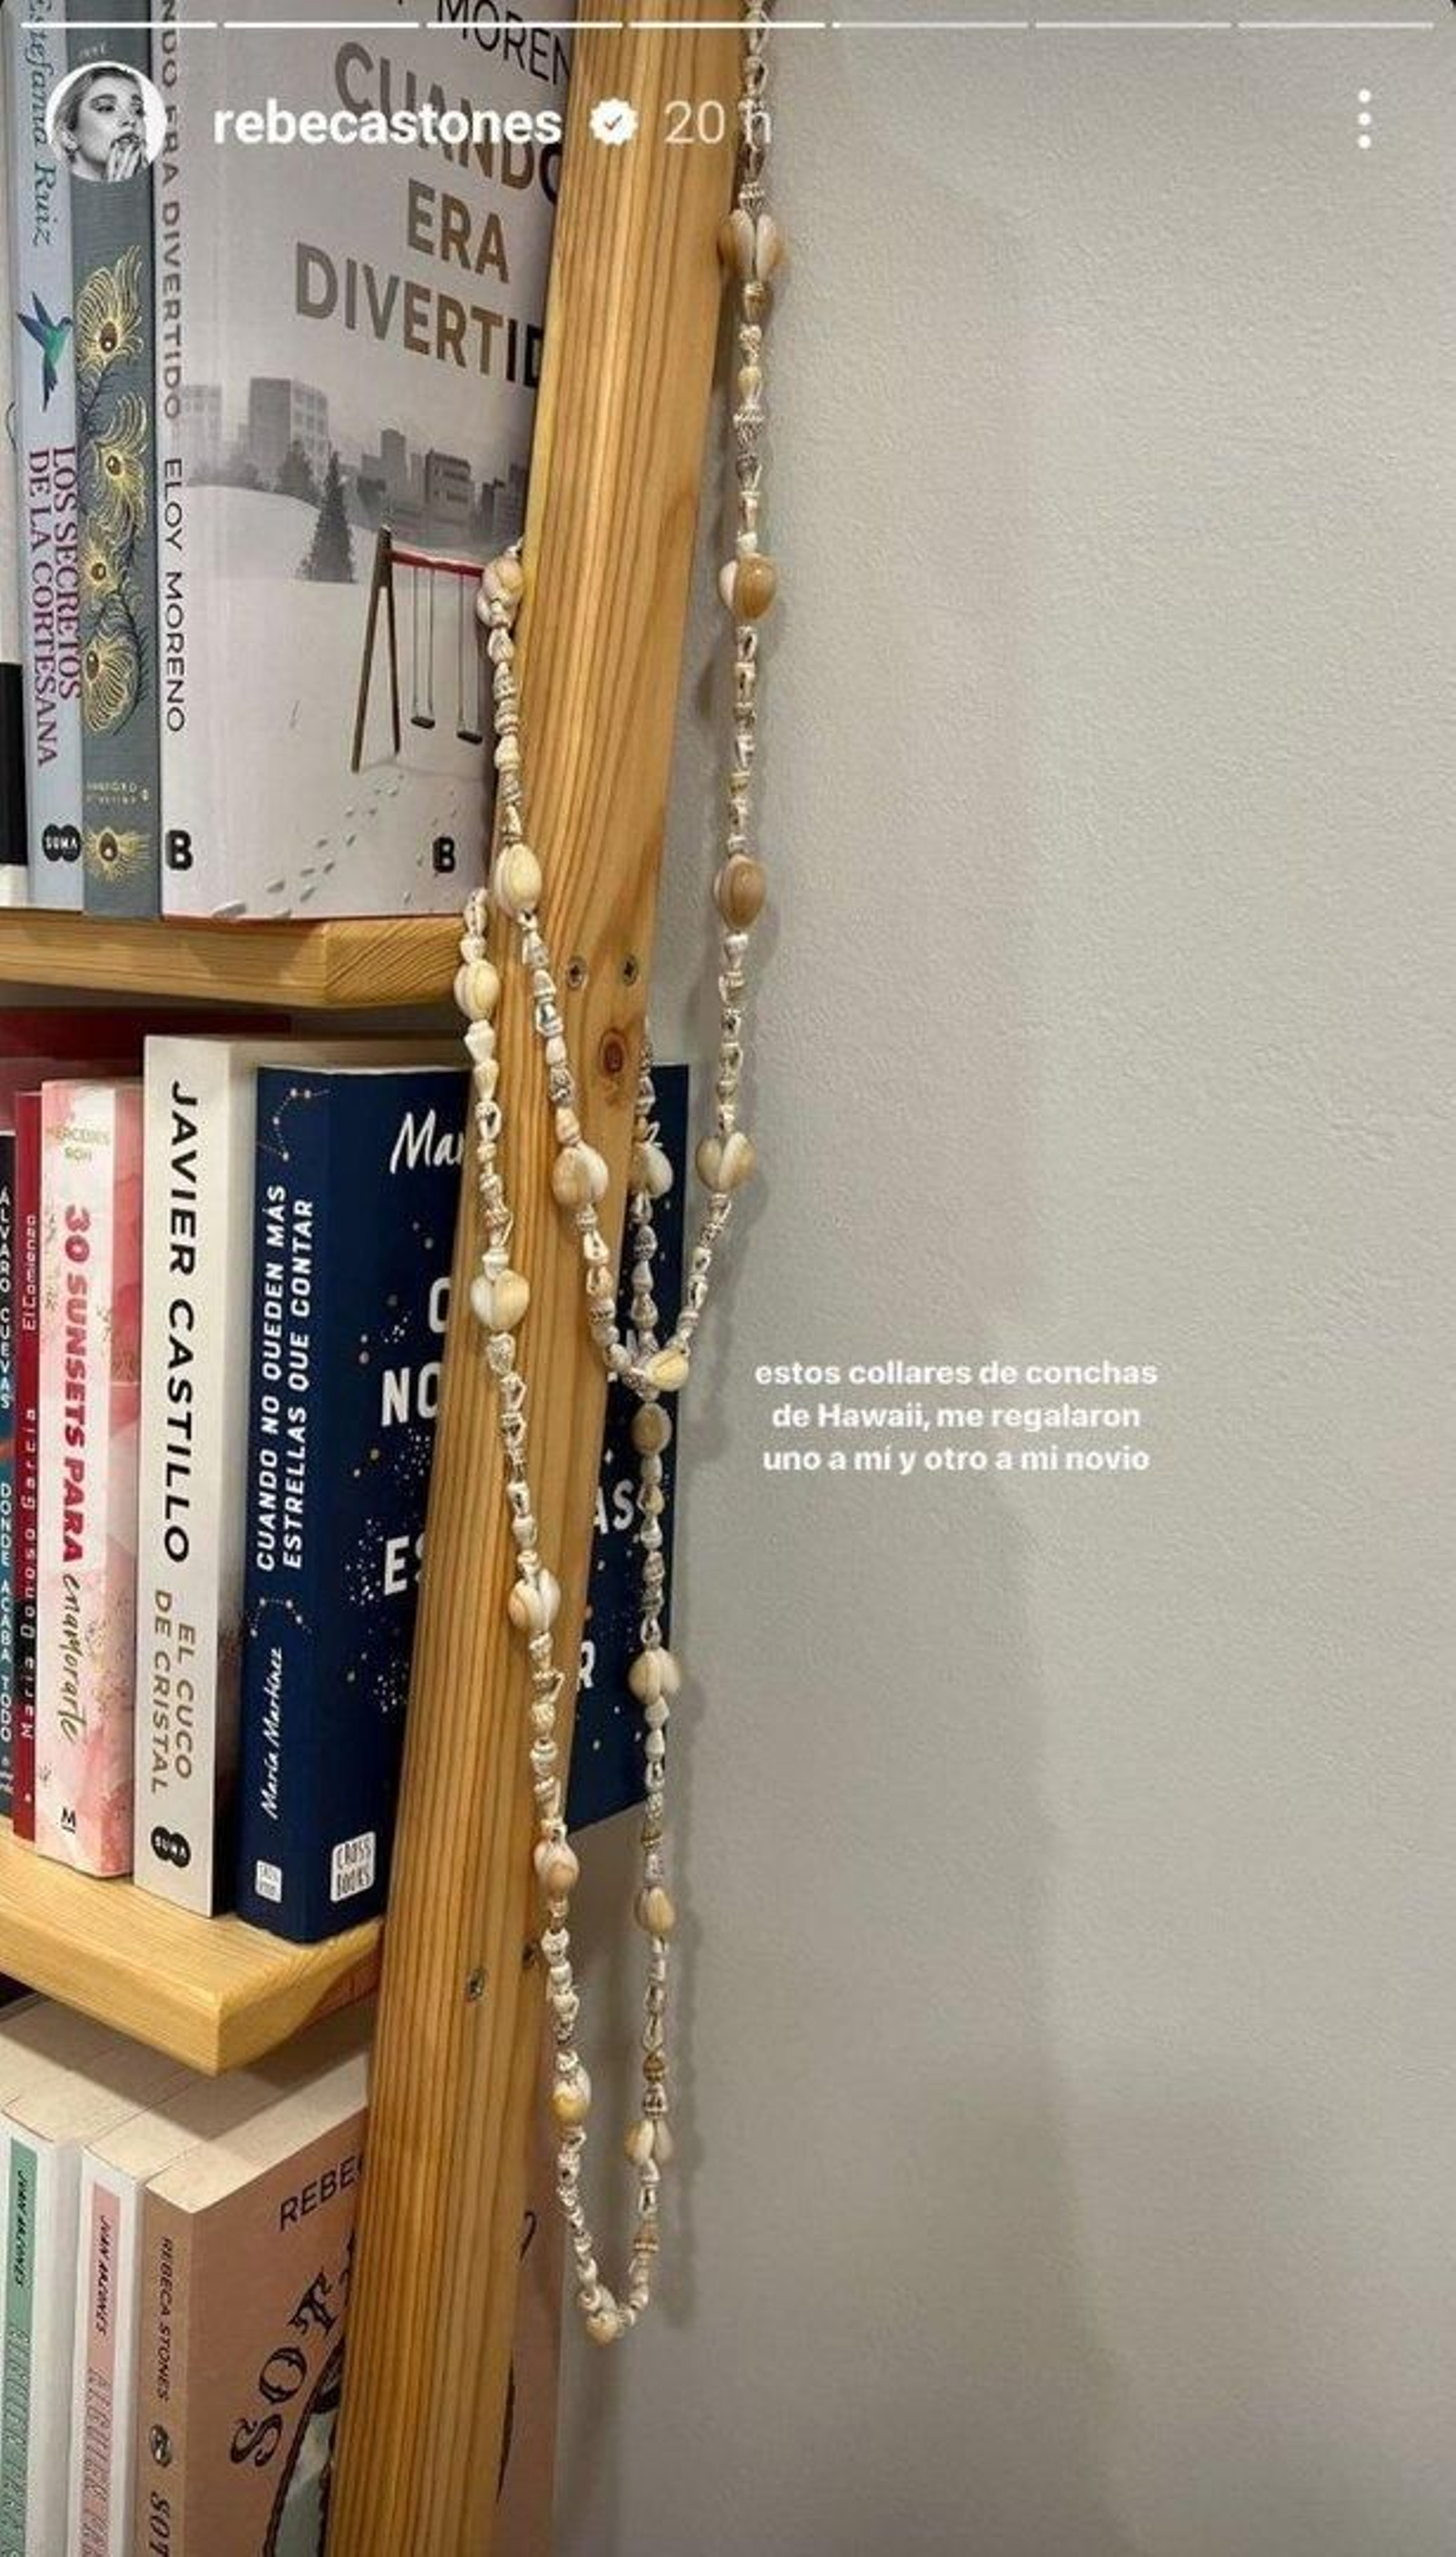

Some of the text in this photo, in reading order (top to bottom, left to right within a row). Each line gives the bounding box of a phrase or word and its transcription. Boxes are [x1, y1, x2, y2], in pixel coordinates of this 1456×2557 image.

[33, 163, 59, 246] Ruiz
[408, 179, 509, 284] ERA
[162, 203, 181, 422] DIVERTIDO
[29, 451, 57, 767] DE LA CORTESANA
[54, 447, 81, 702] LOS SECRETOS
[165, 460, 185, 733] ELOY MORENO
[165, 830, 192, 871] B
[433, 836, 455, 874] B
[165, 1082, 197, 1564] JAVIER CASTILLO
[257, 1184, 287, 1572] CUANDO NO QUEDEN MÁS
[283, 1200, 313, 1570] ESTRELLAS QUE CONTAR
[0, 1482, 12, 1567] DONDE
[59, 1204, 90, 1742] 30 SUNSETS PARA enamorarte
[151, 1590, 172, 1795] DE CRISTAL
[175, 1622, 196, 1780] EL CUCO
[99, 2215, 111, 2260] JUAN
[280, 2152, 363, 2232] REBE
[157, 2236, 173, 2402] REBECA STONES
